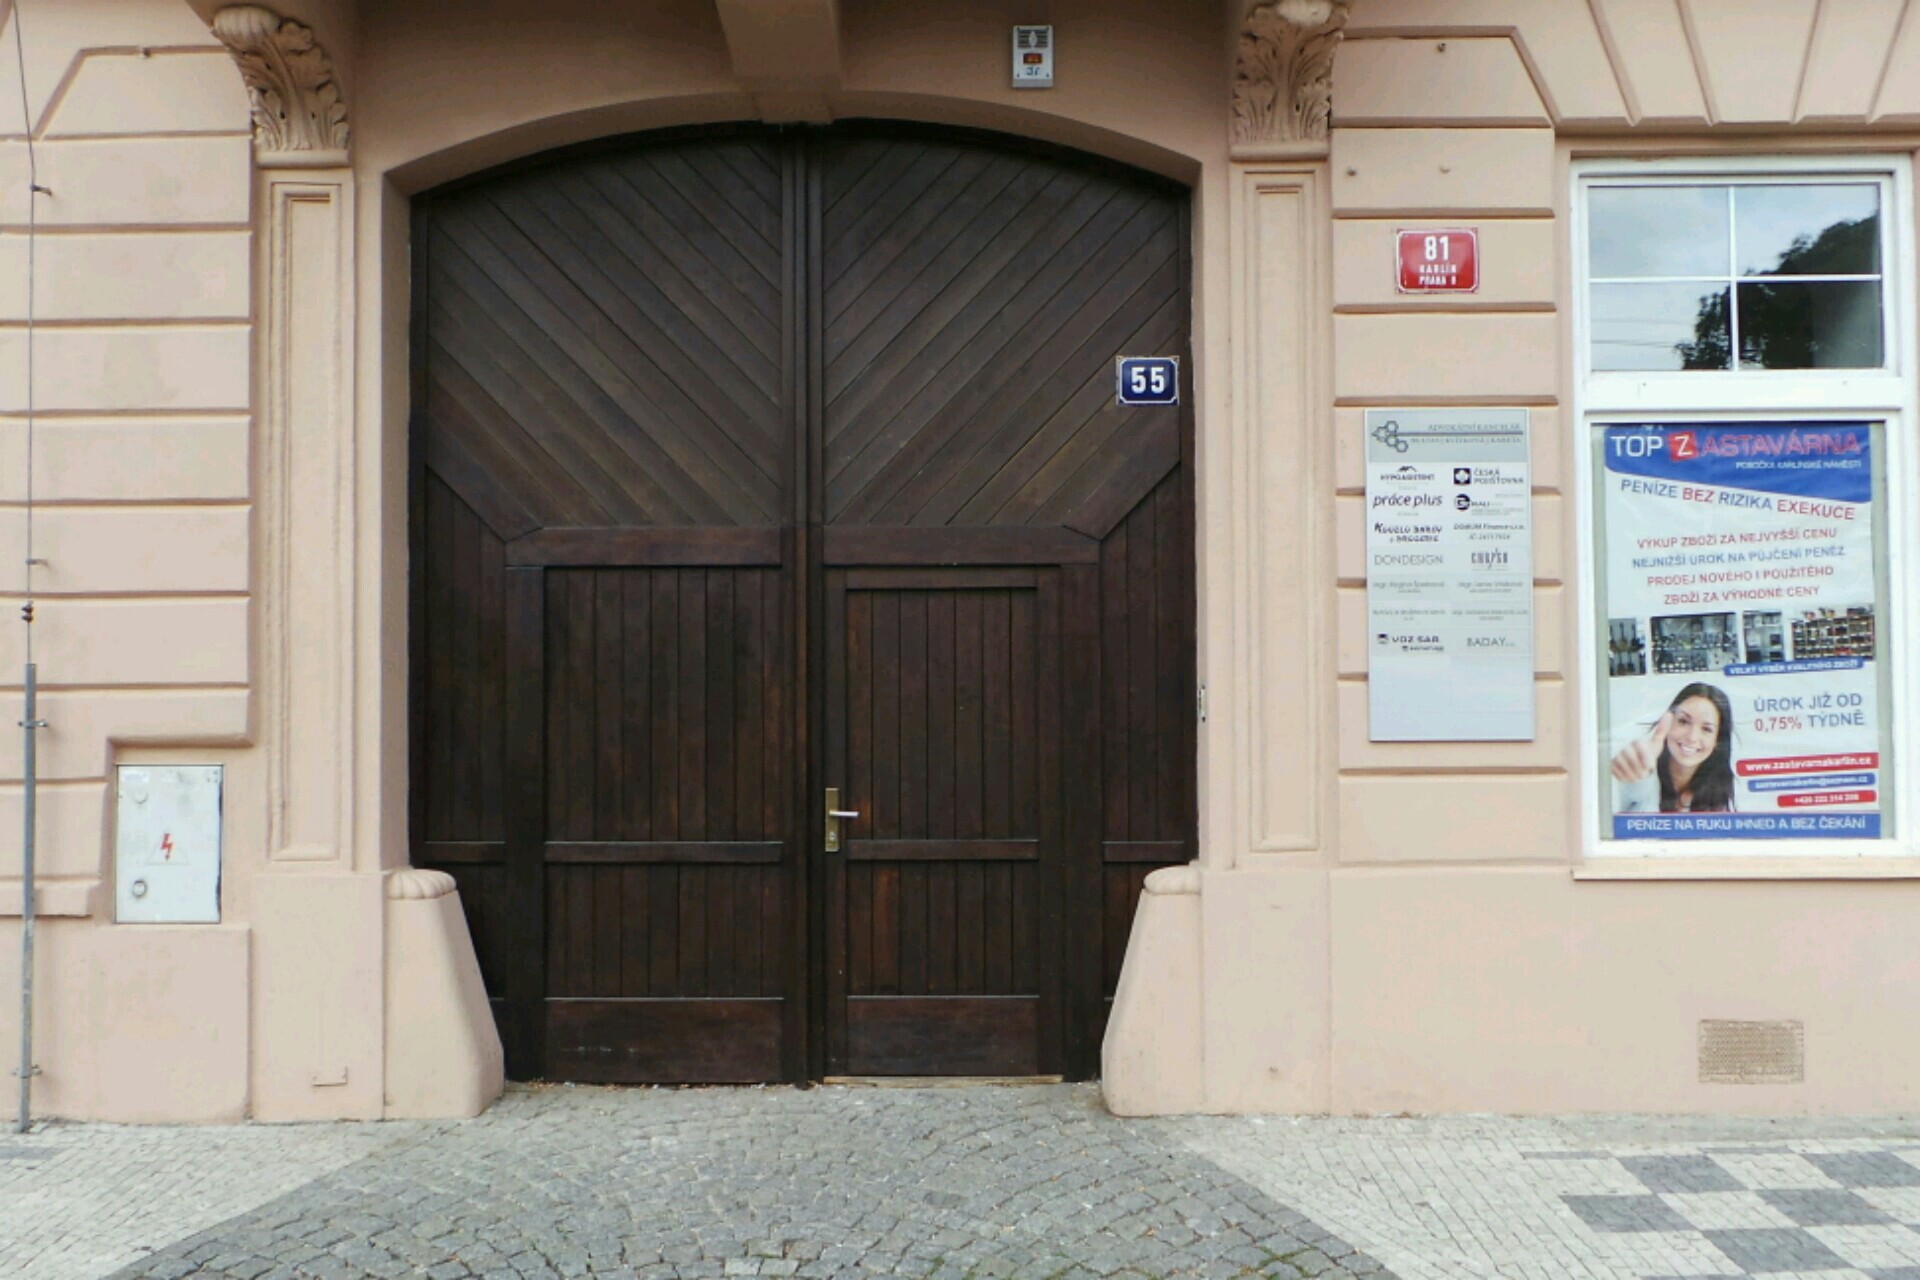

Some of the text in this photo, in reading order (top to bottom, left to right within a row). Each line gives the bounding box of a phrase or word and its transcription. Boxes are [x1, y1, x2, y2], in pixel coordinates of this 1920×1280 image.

[1425, 235, 1449, 261] 81
[1418, 275, 1447, 286] PRAHA
[1131, 366, 1165, 394] 55
[1610, 435, 1663, 457] TOP
[1372, 493, 1443, 508] práce plus
[1621, 479, 1855, 520] PENÍZE BEZ RIZIKA EXEKUCE
[1720, 534, 1736, 545] ZA
[1803, 527, 1838, 540] CENU
[1728, 551, 1746, 563] NA
[1647, 574, 1696, 587] PRODEJ
[1702, 591, 1719, 603] ZA
[1786, 585, 1820, 598] CENY
[1753, 692, 1862, 712] ÚROK JIŽ OD
[1754, 709, 1865, 732] 0,75% TÝDNĚ
[1626, 815, 1866, 831] PENÍZE NA RUKU IHNED A BEZ ČEKÁNÍ
